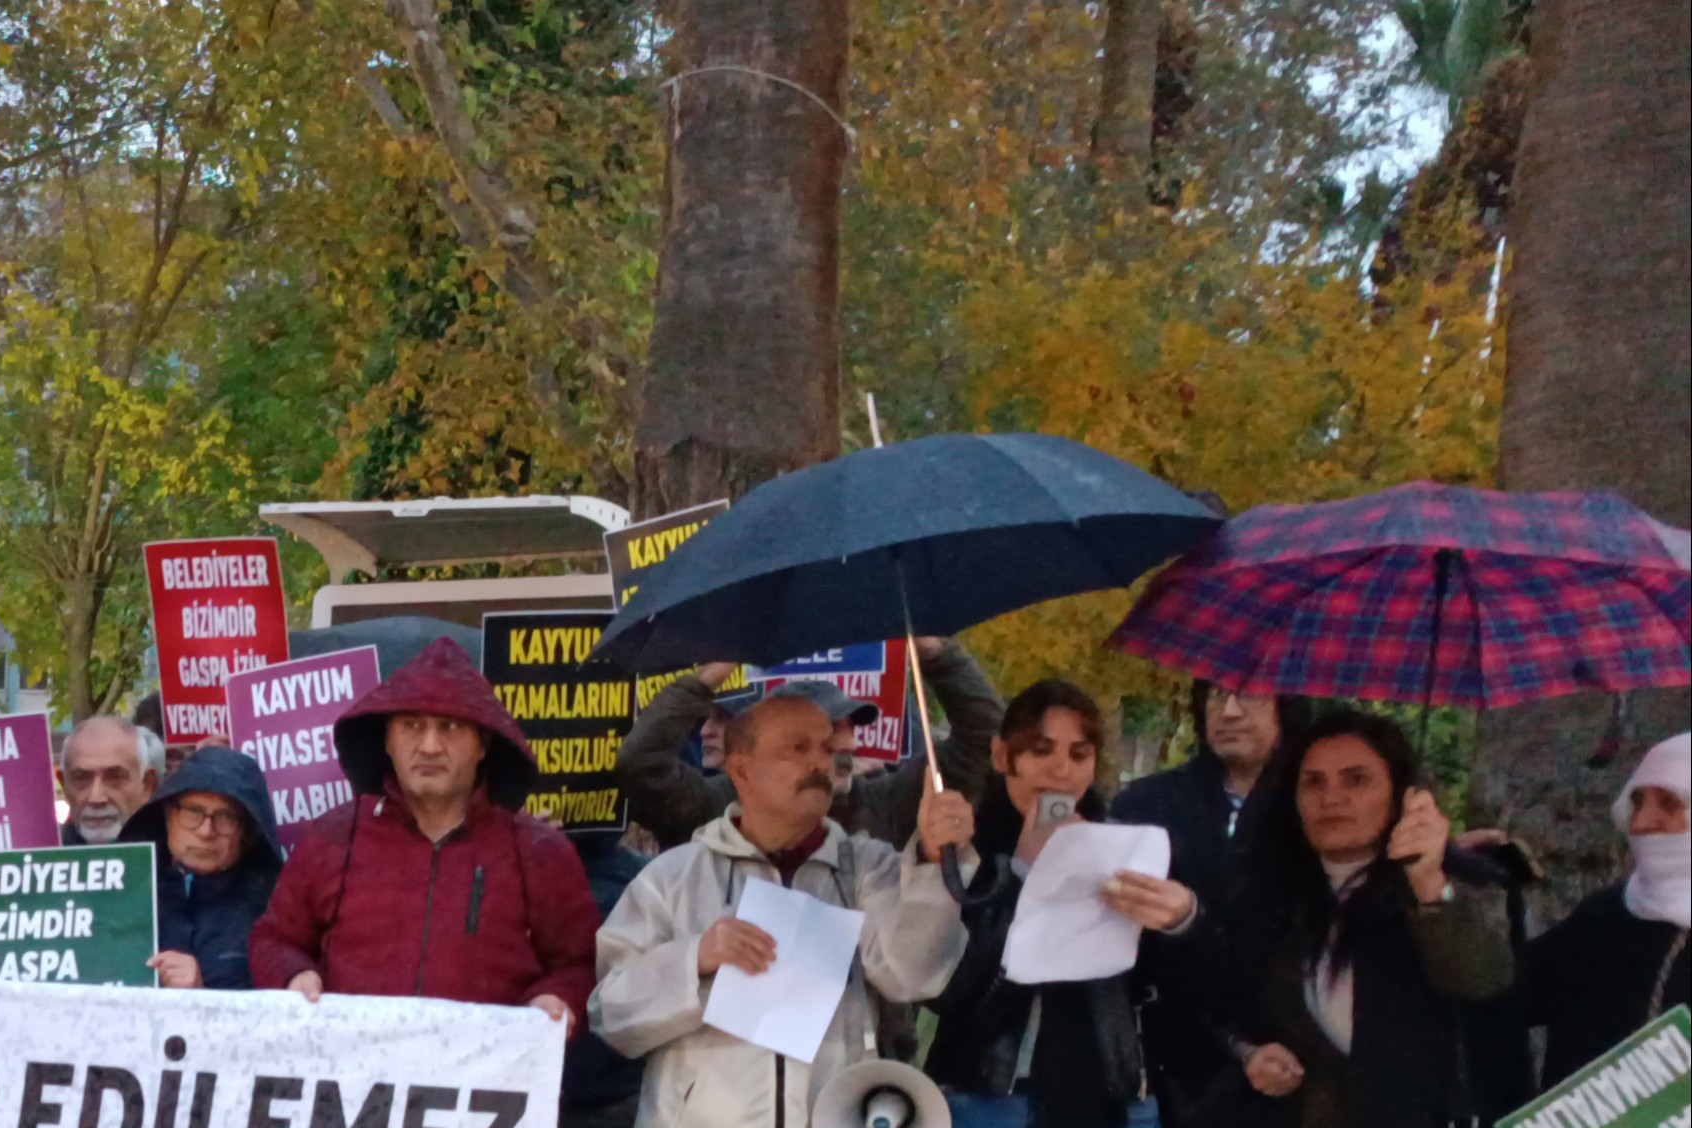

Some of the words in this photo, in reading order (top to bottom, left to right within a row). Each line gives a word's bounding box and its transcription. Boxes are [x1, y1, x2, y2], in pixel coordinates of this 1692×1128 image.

[160, 549, 270, 590] BELEDİYELER
[181, 597, 257, 639] BİZİMDİR
[178, 655, 230, 688] GASPA
[251, 664, 354, 718] KAYYUM
[166, 703, 227, 735] VERMEY
[241, 723, 339, 772] SİYASET
